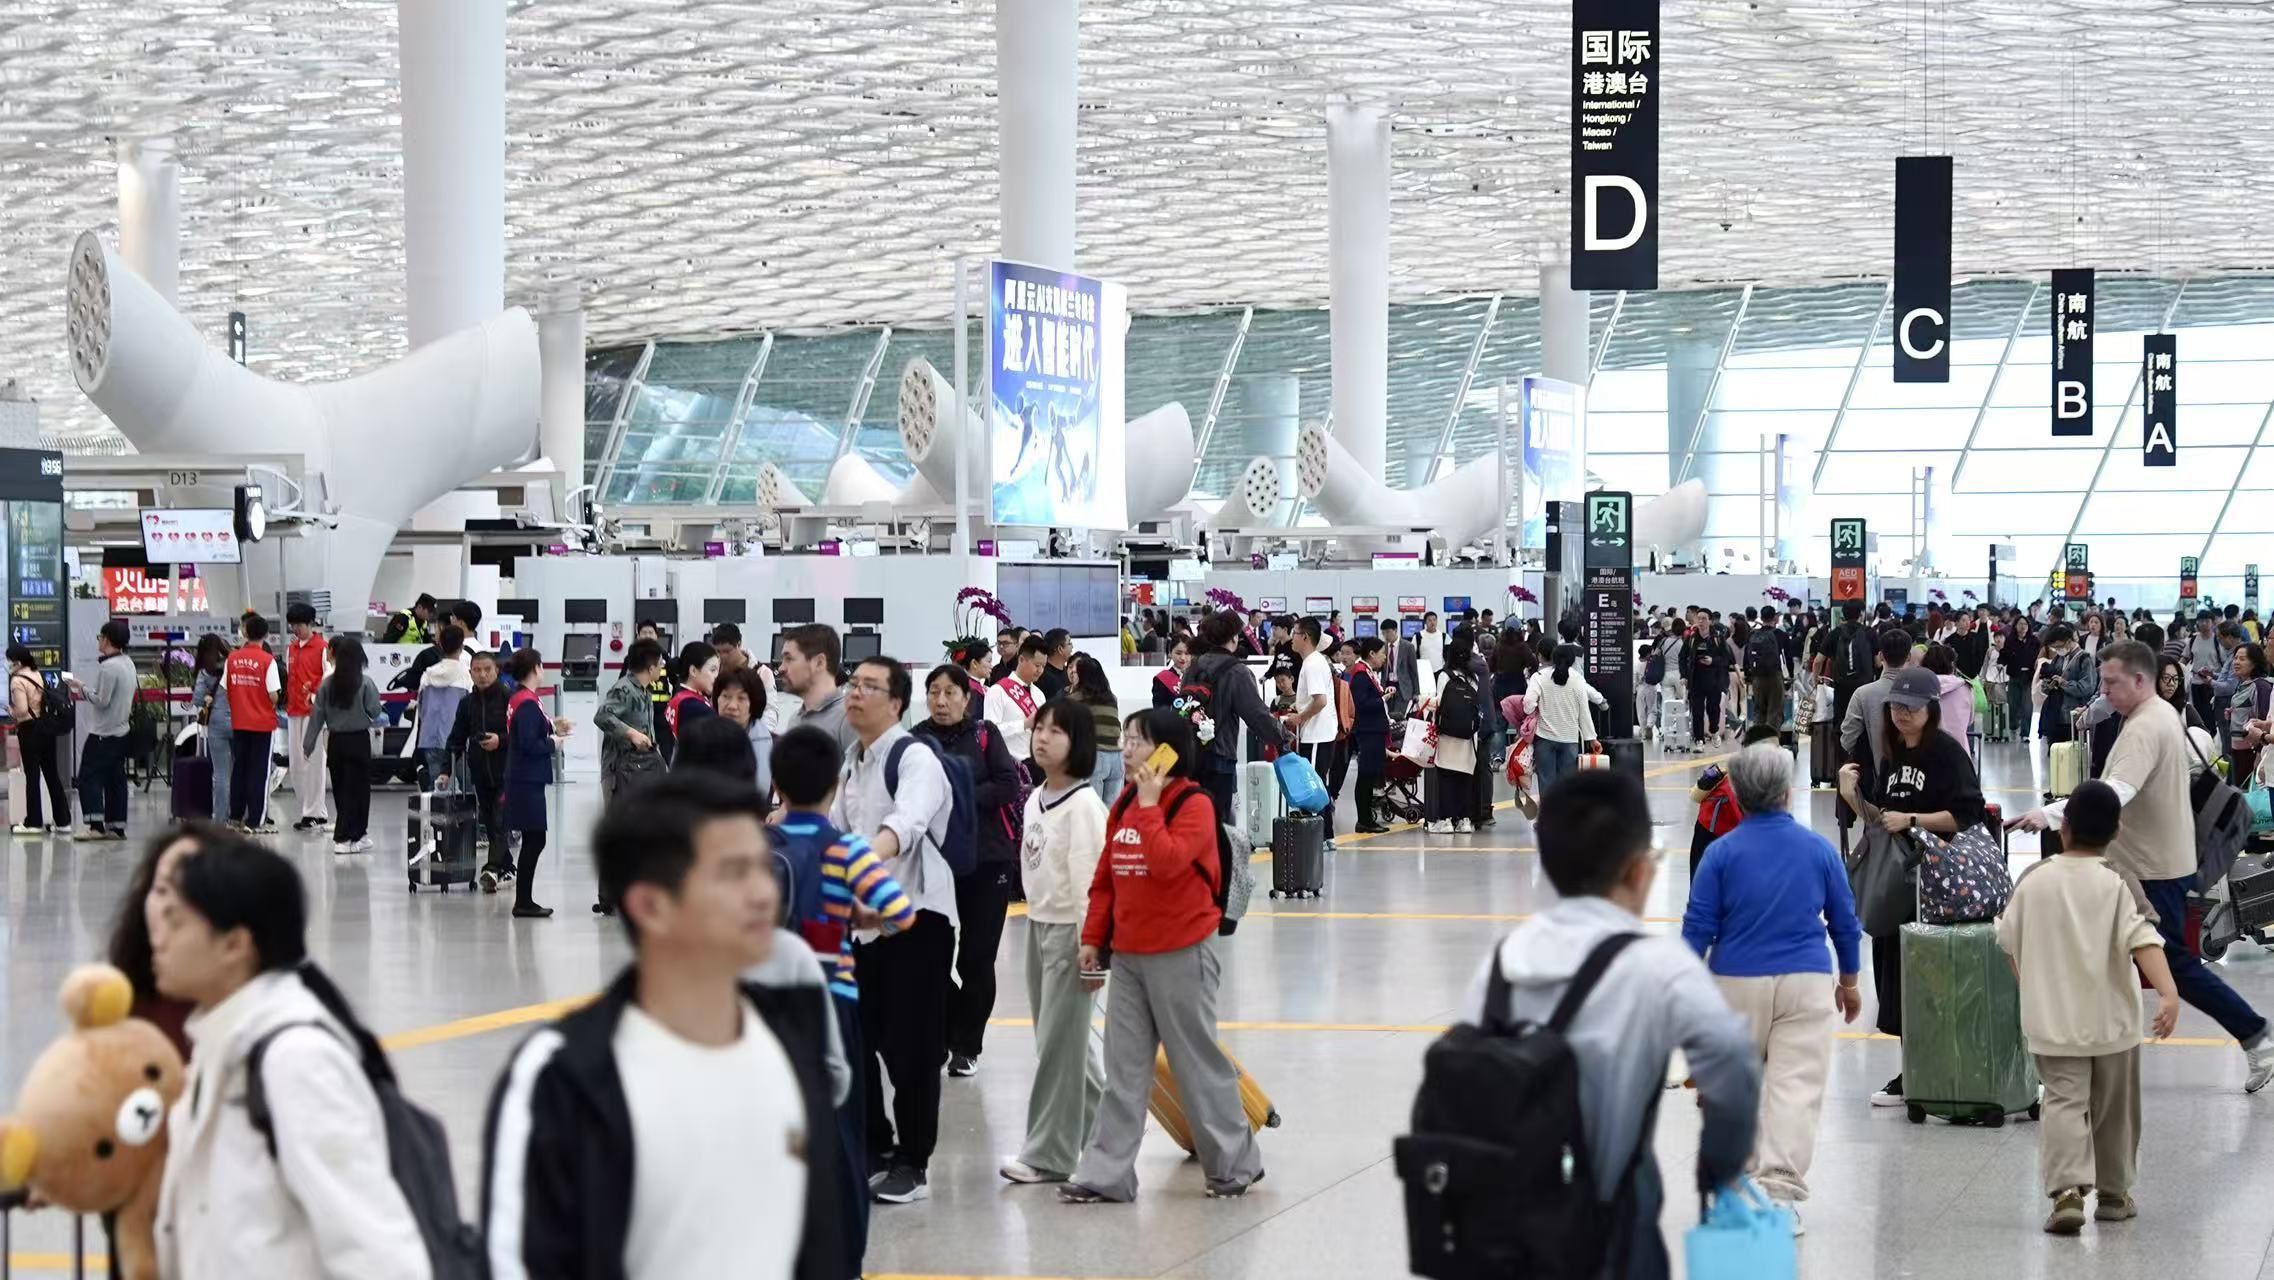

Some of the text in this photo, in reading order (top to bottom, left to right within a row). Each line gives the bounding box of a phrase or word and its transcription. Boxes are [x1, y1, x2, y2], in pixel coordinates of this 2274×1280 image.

[1582, 30, 1652, 66] 国际
[1583, 70, 1649, 95] 港澳台
[1583, 100, 1635, 109] International
[1583, 113, 1626, 125] Hongkong
[1583, 127, 1612, 137] Macao
[1583, 141, 1613, 150] Taiwan
[1584, 174, 1648, 251] D
[2067, 292, 2088, 341] 南航
[1899, 307, 1945, 360] C
[2155, 353, 2172, 391] 南航
[2057, 381, 2088, 419] B
[2145, 422, 2175, 453] A
[170, 472, 198, 486] D13
[1839, 569, 1857, 577] AED
